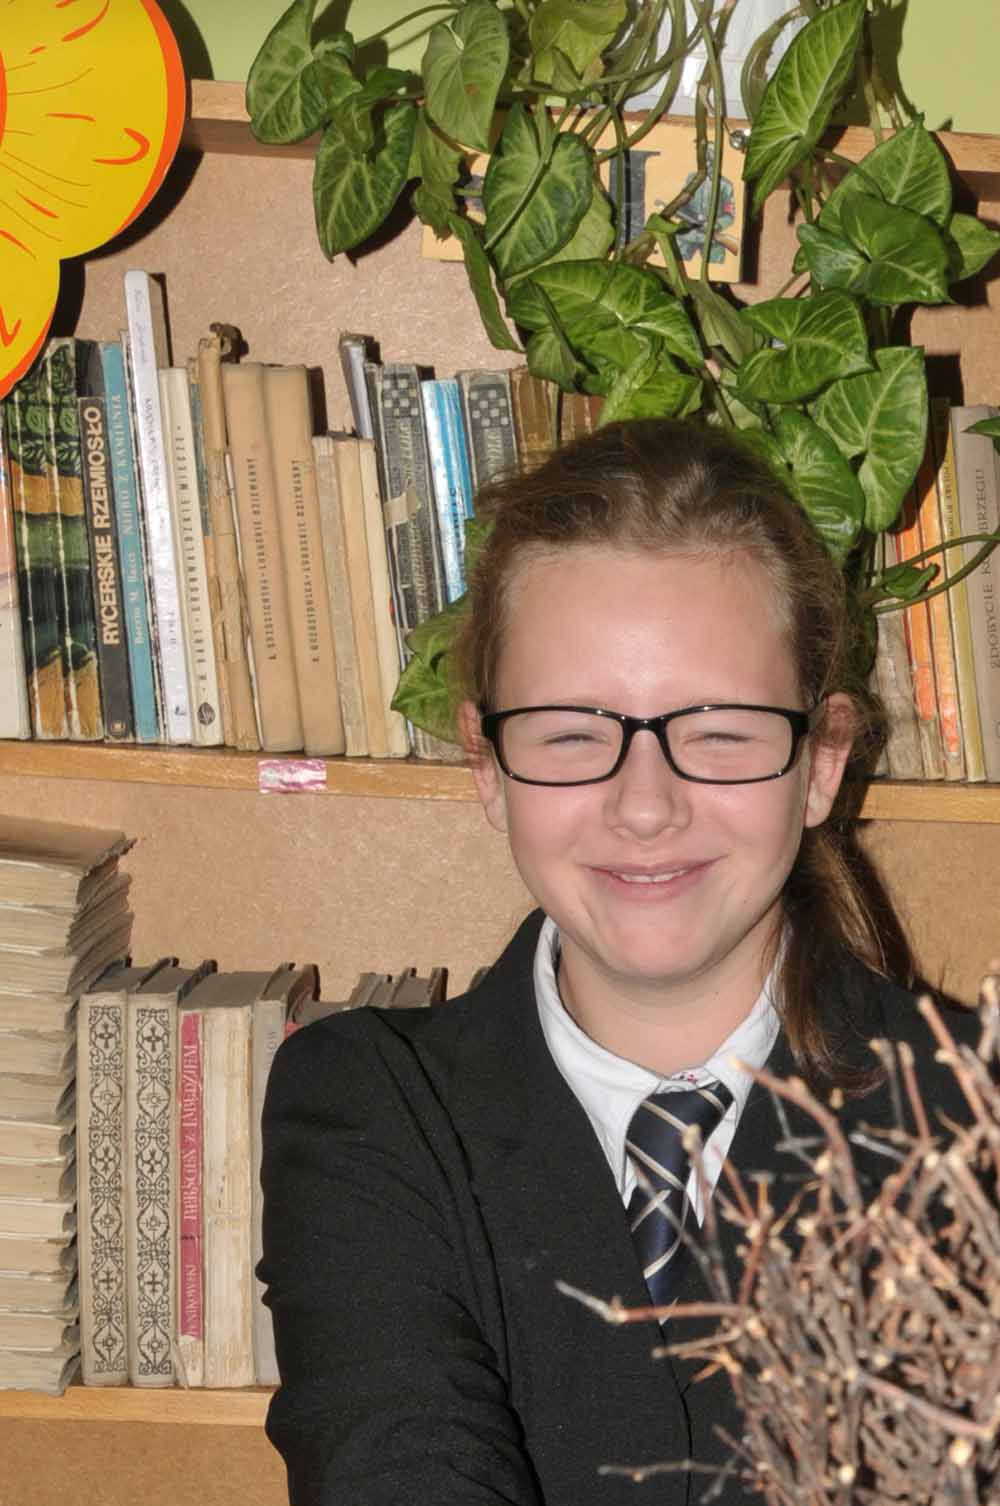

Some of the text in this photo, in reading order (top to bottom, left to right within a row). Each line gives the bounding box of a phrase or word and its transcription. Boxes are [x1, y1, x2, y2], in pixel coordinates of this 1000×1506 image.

[110, 394, 128, 468] KAMIENIA
[85, 407, 120, 645] RYCERSKIE RZEMIOSŁO
[119, 489, 134, 535] NIEBO
[976, 468, 1000, 669] ZDOBYCIE KOBRZEGU
